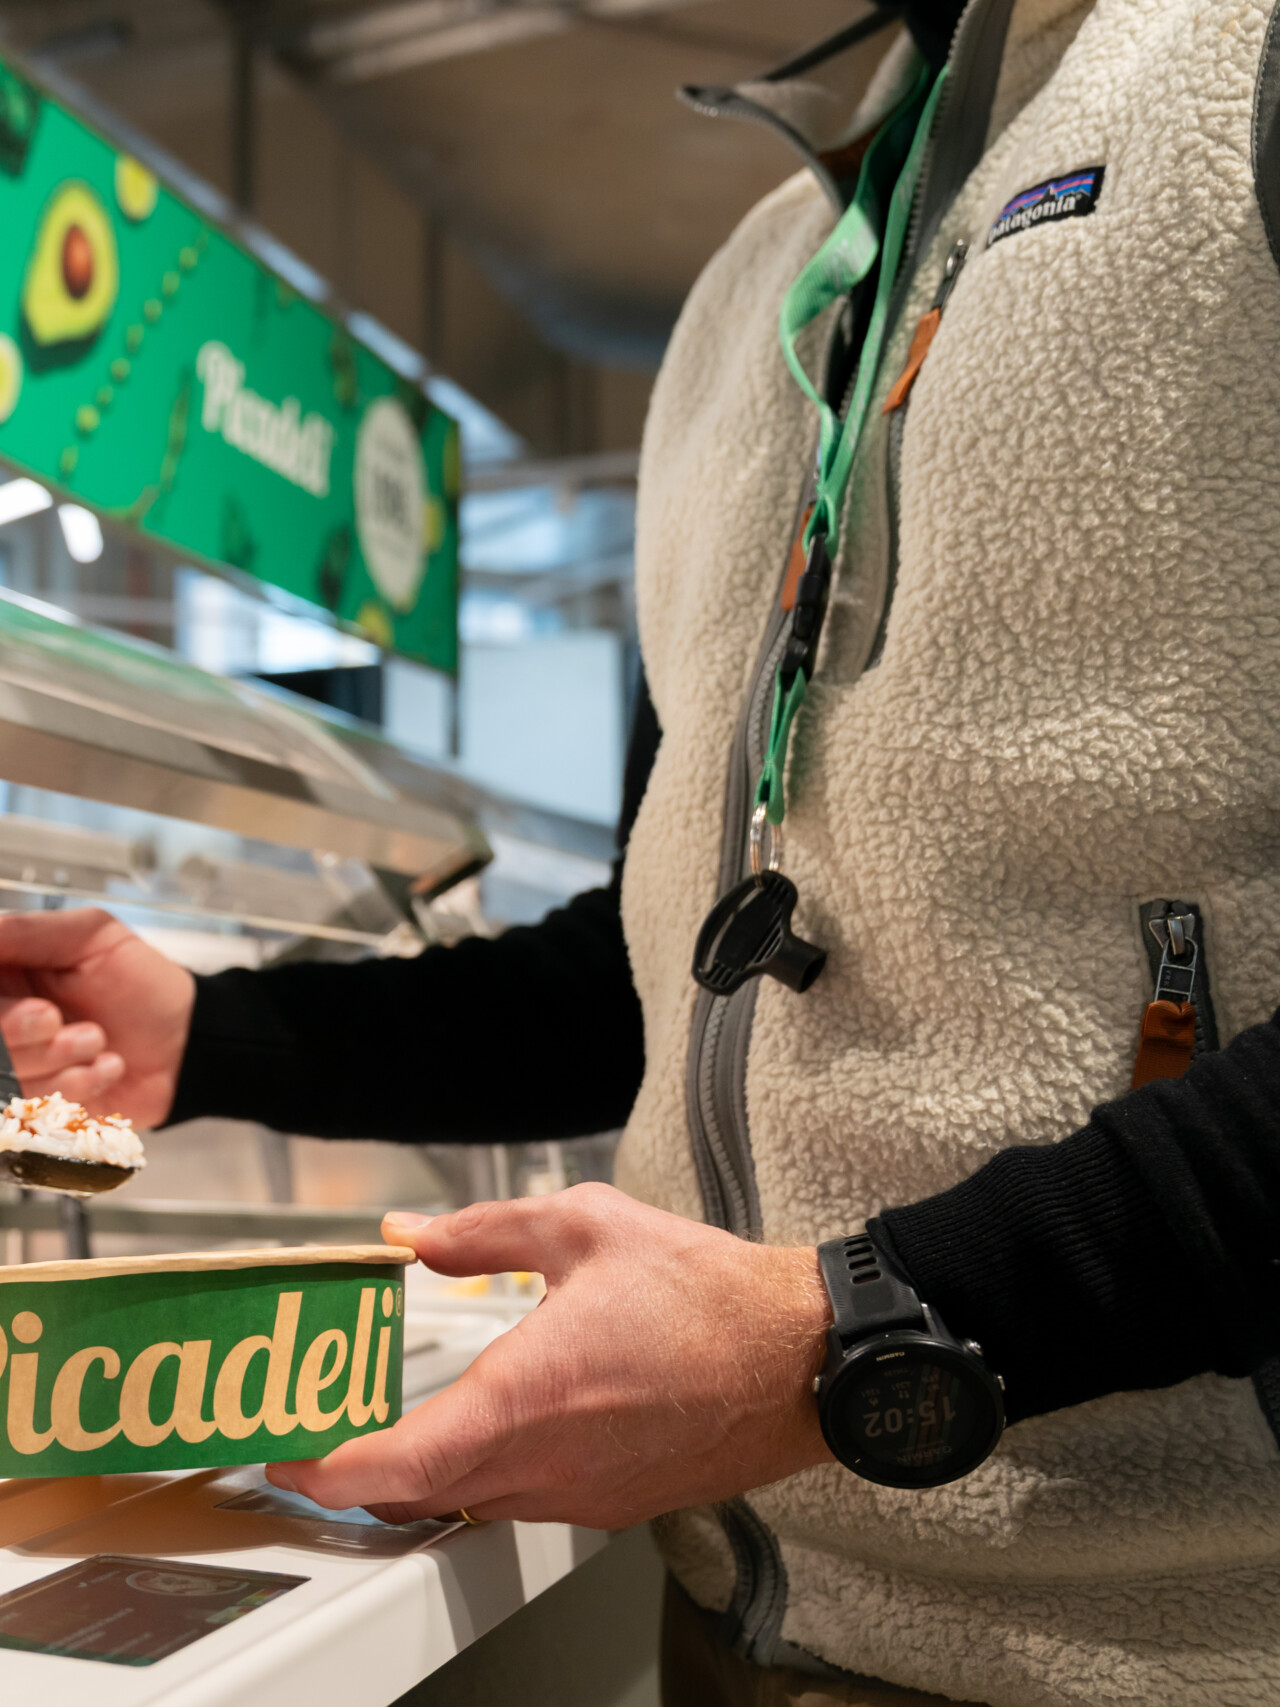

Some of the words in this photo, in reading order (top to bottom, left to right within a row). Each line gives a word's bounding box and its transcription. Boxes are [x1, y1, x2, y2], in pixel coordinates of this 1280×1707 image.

[988, 195, 1077, 245] patagonia
[863, 1396, 956, 1438] 15:02
[897, 1445, 952, 1463] GARMIN
